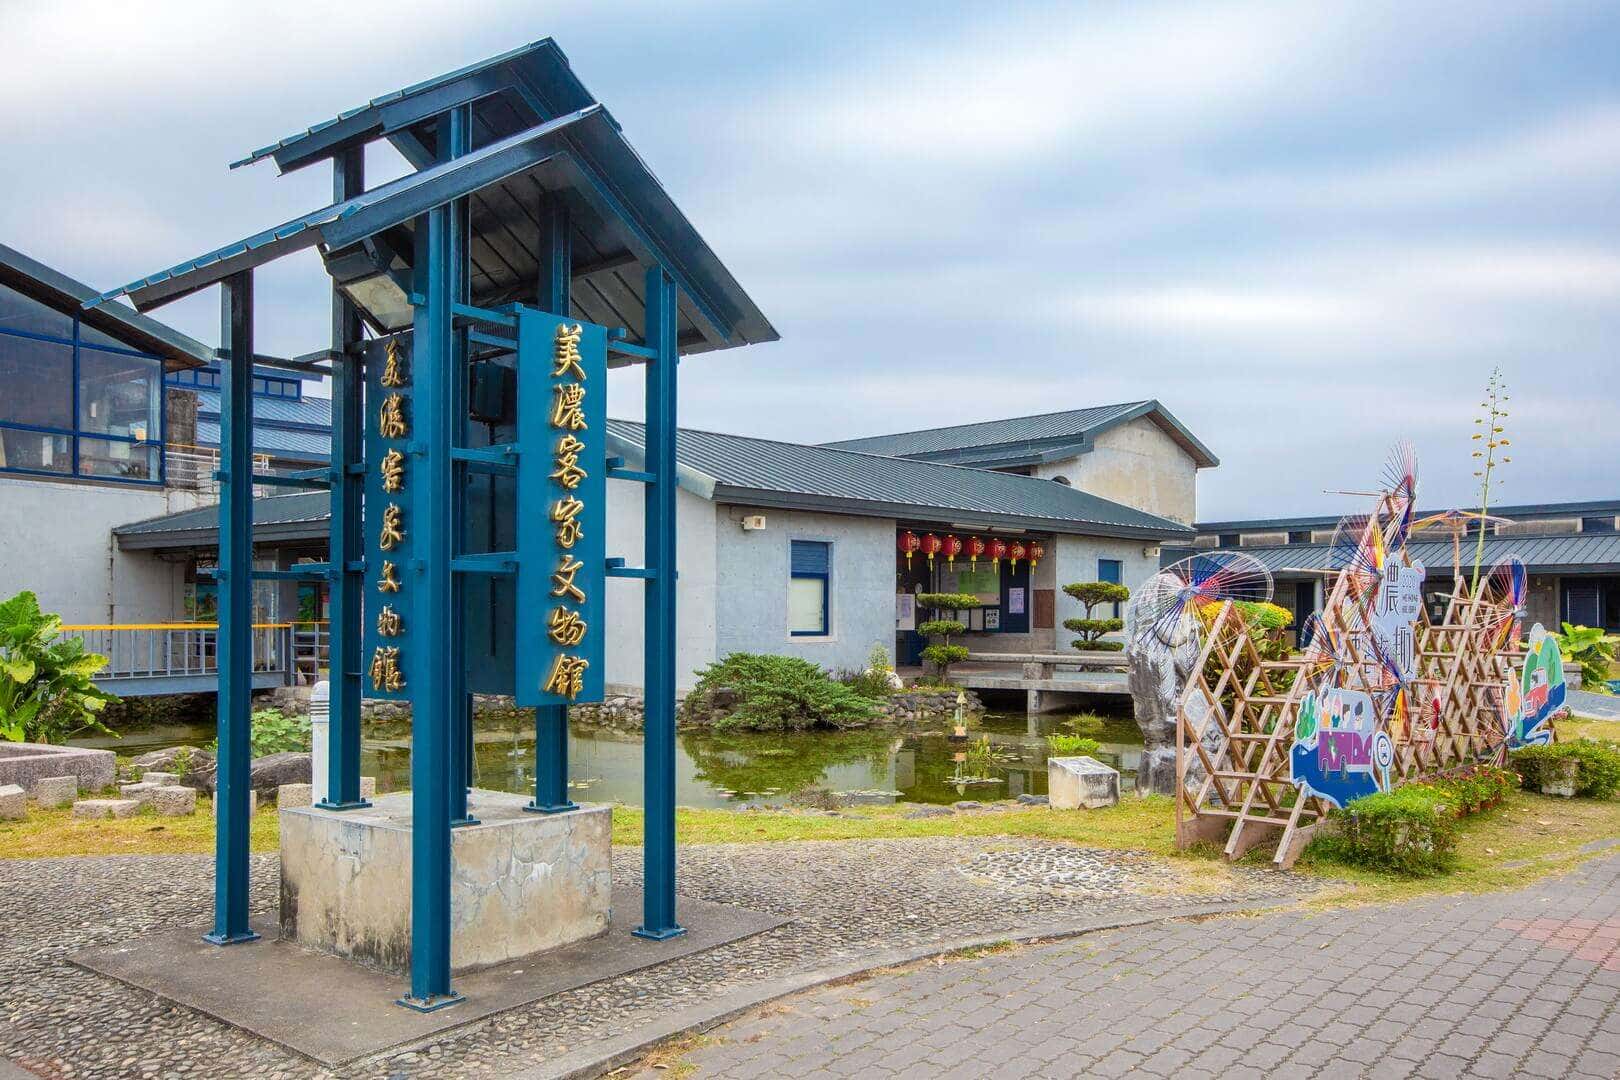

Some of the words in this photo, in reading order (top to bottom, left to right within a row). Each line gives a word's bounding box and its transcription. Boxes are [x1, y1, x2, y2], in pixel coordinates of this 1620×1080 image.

[544, 323, 589, 701] 美濃客家文物館
